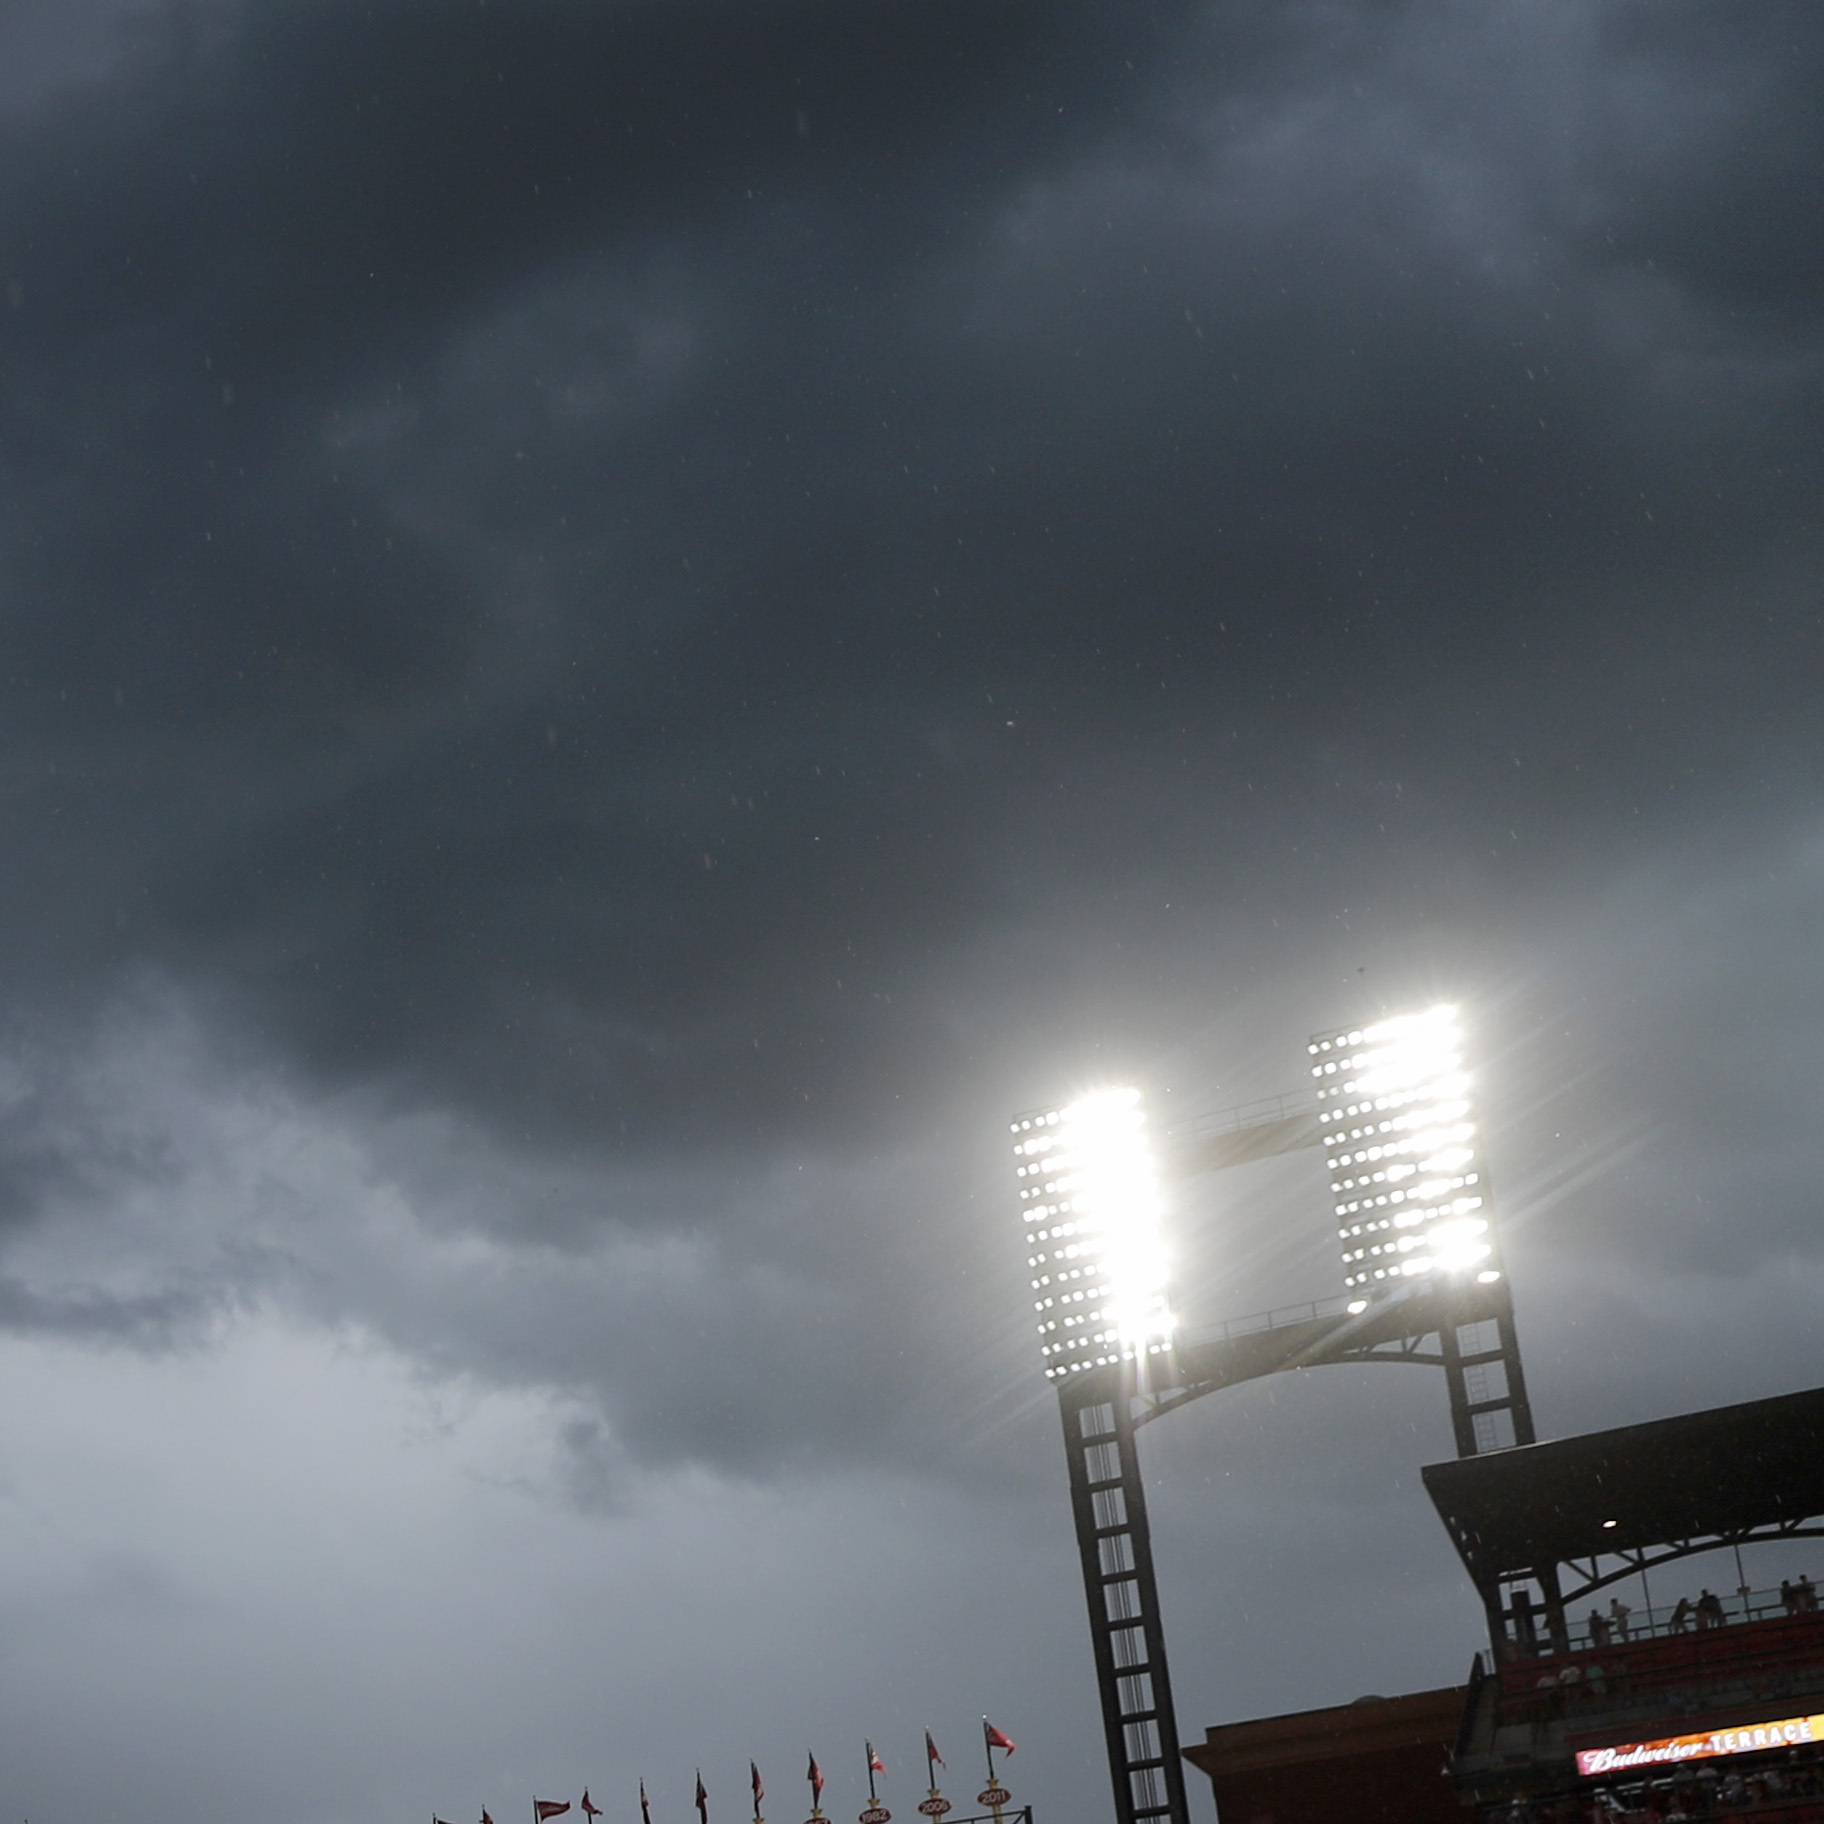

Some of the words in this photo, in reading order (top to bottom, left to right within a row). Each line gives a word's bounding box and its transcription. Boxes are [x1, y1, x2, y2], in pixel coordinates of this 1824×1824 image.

[1709, 1720, 1812, 1753] TERRACE
[860, 1809, 887, 1824] 1982
[980, 1791, 1007, 1804] 2011
